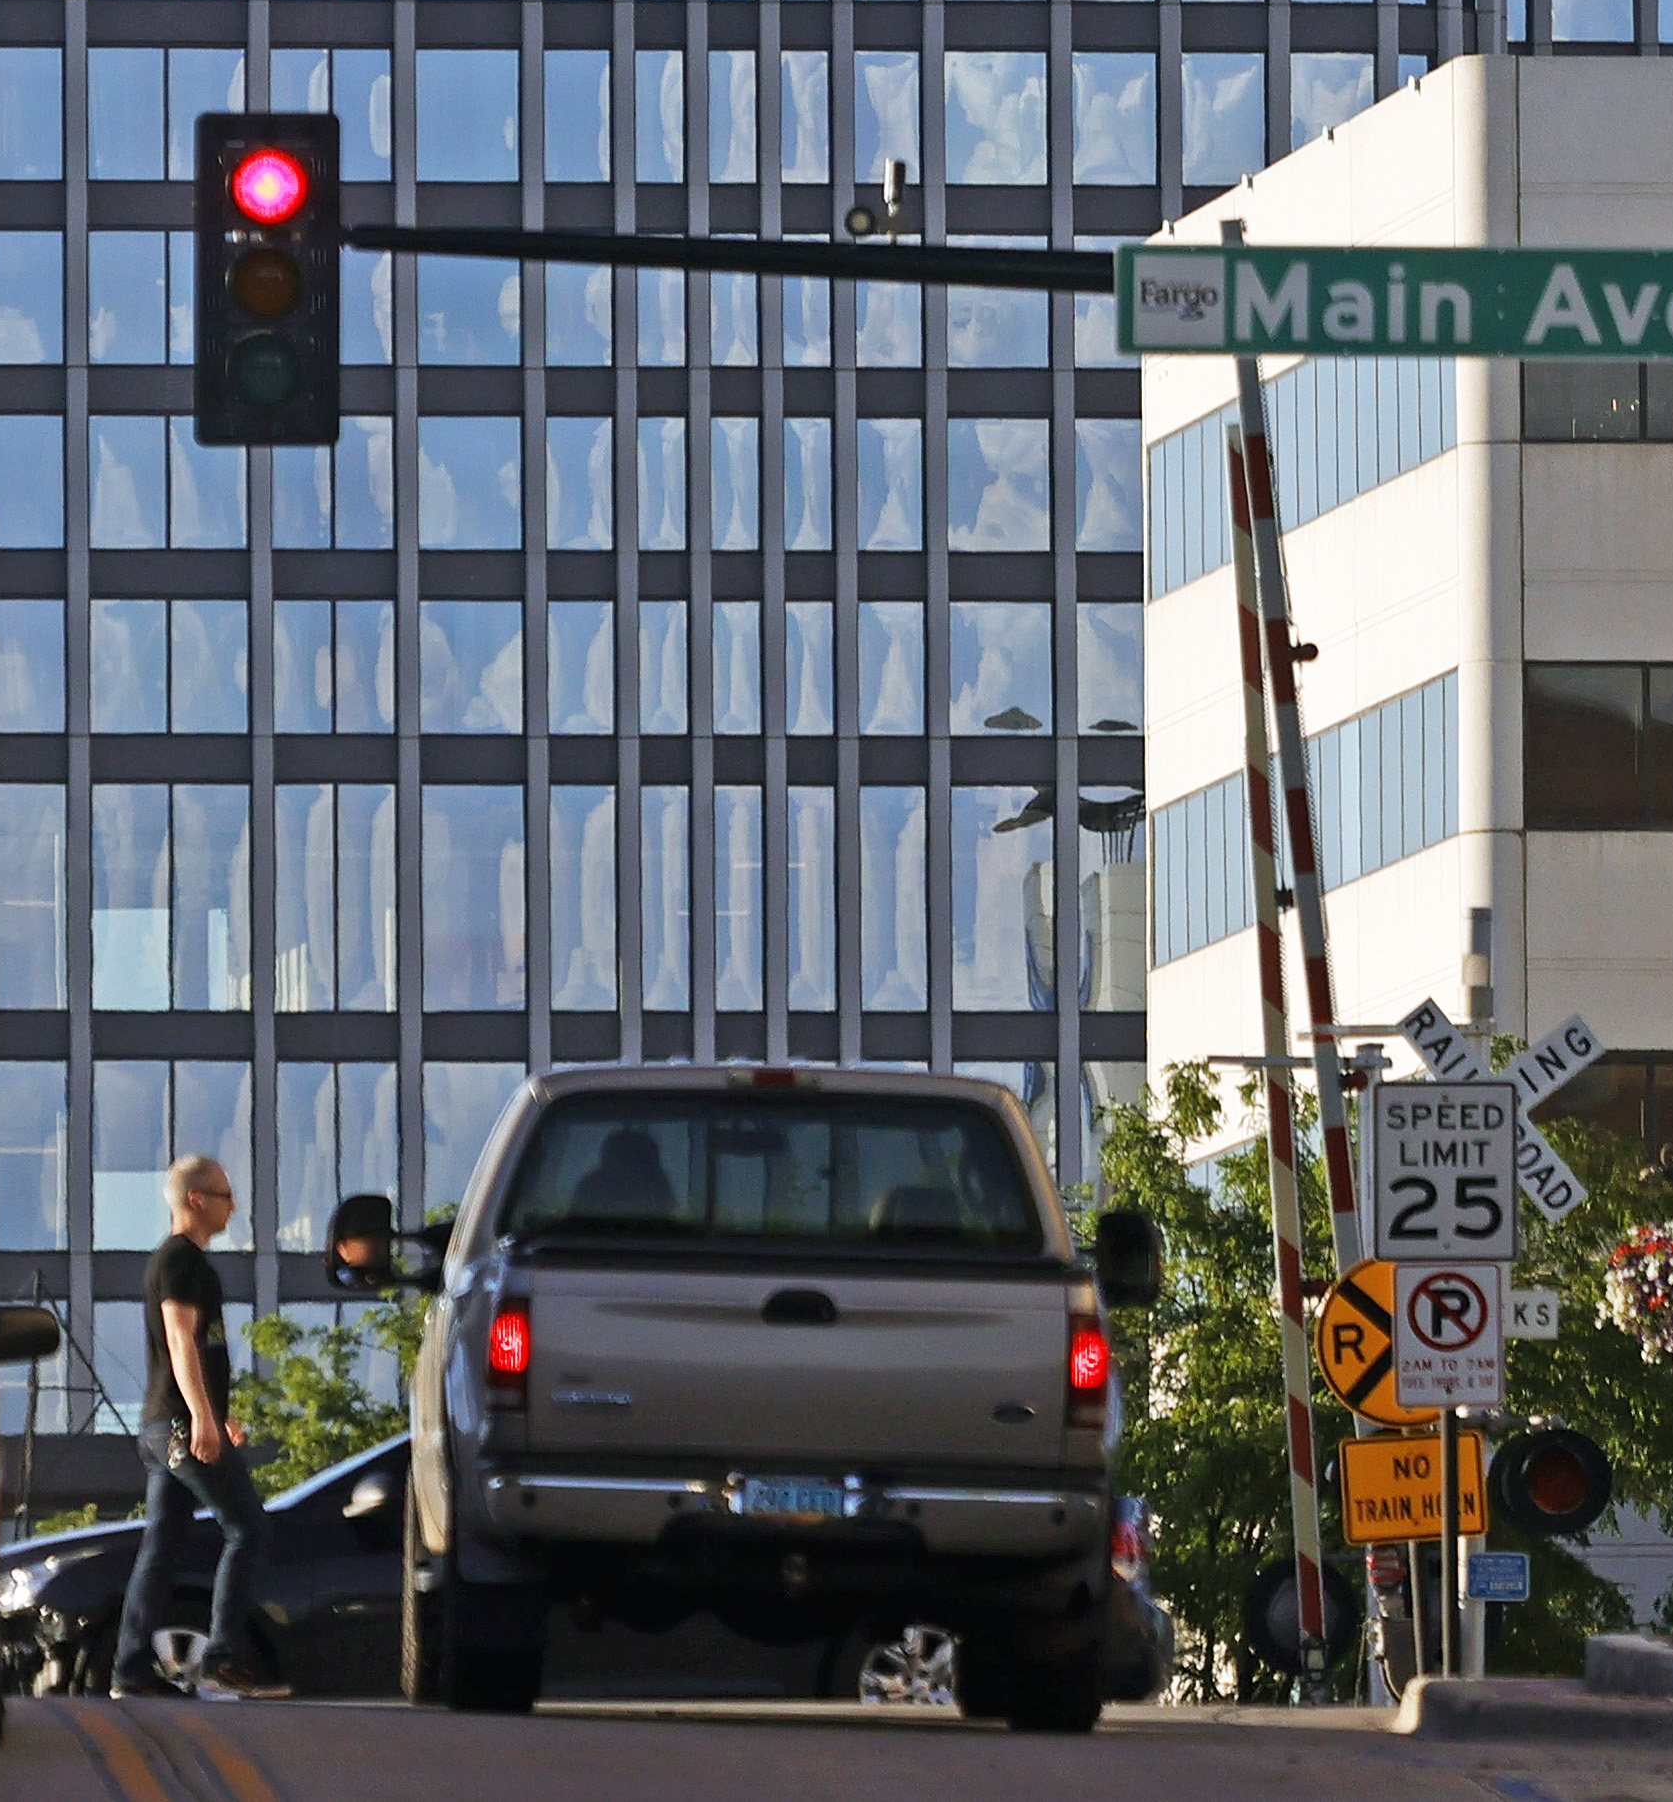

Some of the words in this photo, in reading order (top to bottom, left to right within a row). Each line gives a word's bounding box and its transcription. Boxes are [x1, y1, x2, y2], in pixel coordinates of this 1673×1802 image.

[1140, 278, 1219, 322] Fargo
[1233, 261, 1472, 343] Main
[1386, 1103, 1506, 1131] SPEED
[1399, 1140, 1491, 1168] LIMIT
[1388, 1175, 1503, 1240] 25
[1333, 1323, 1365, 1364] R
[1393, 1455, 1431, 1480] NO
[1354, 1495, 1413, 1524] TRAIN
[1422, 1492, 1477, 1519] HN
